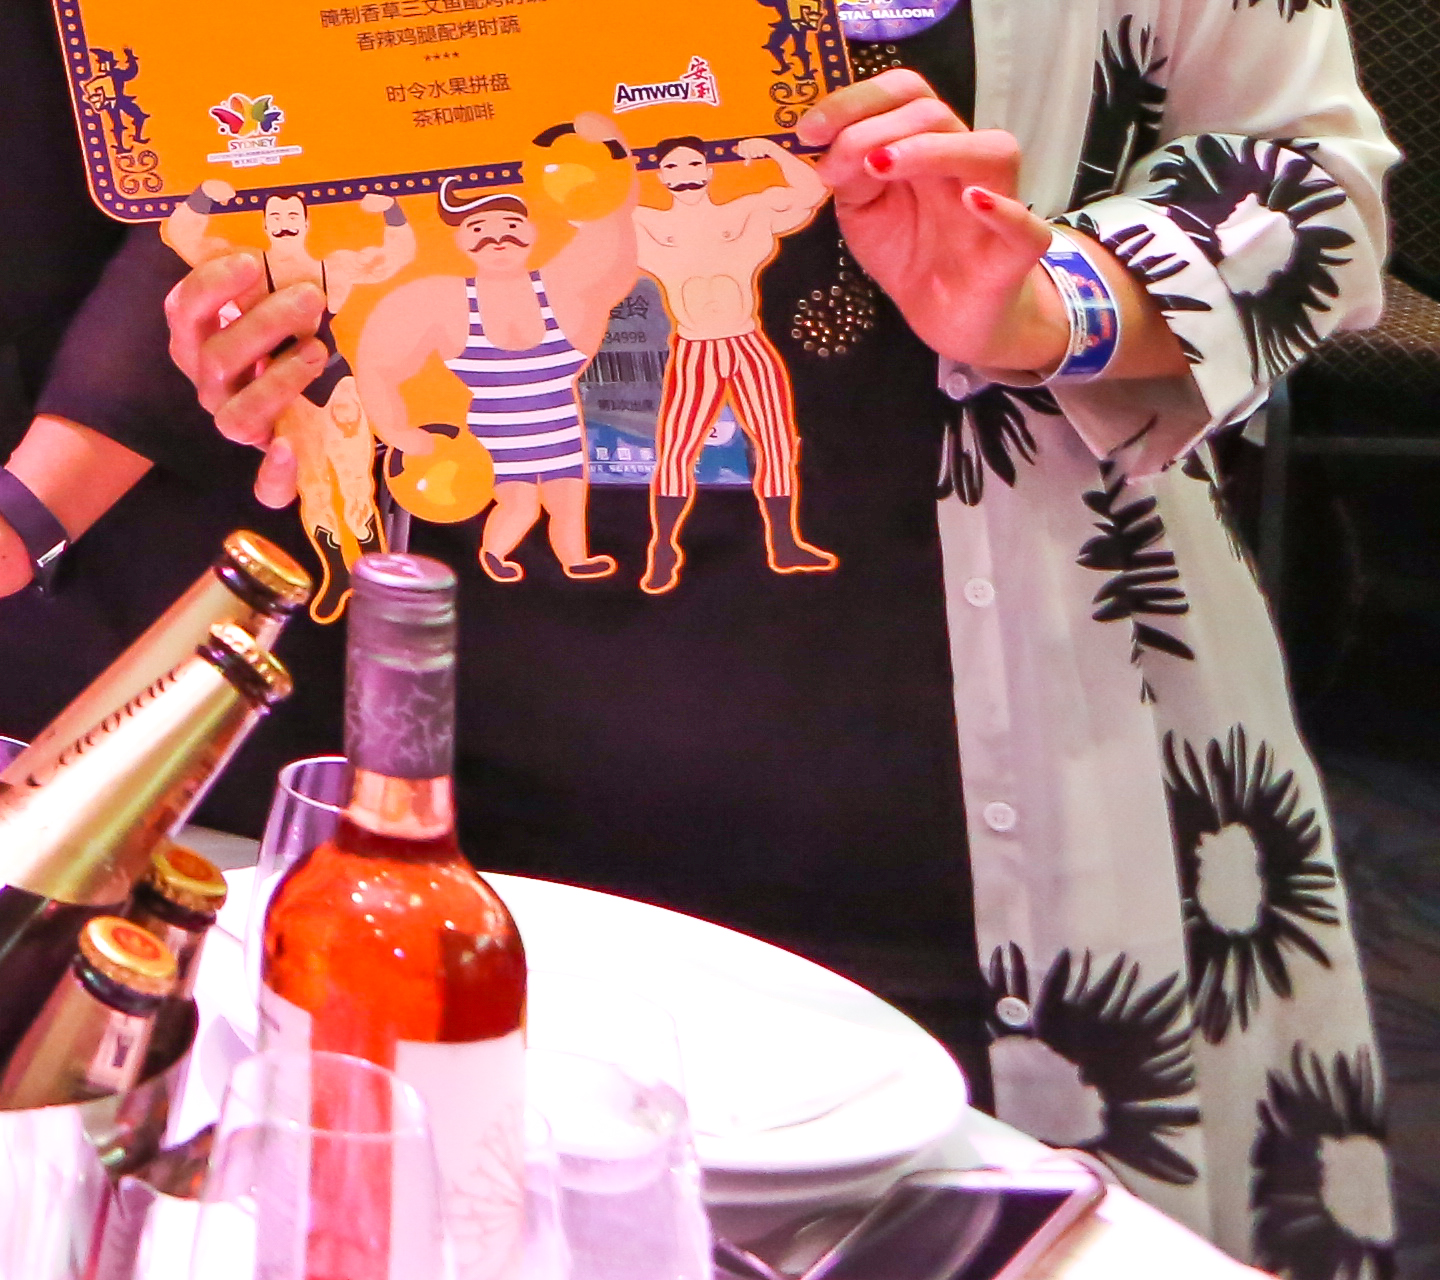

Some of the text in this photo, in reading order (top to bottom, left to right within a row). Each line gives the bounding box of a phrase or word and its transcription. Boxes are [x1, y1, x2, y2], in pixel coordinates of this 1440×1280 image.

[838, 11, 867, 21] STAL
[355, 13, 521, 54] 香辣鸡腿配烤时蔬
[385, 70, 512, 106] 时令水果拼盘
[614, 76, 691, 108] Amway
[411, 100, 496, 129] 茶和咖啡
[710, 427, 718, 438] 2
